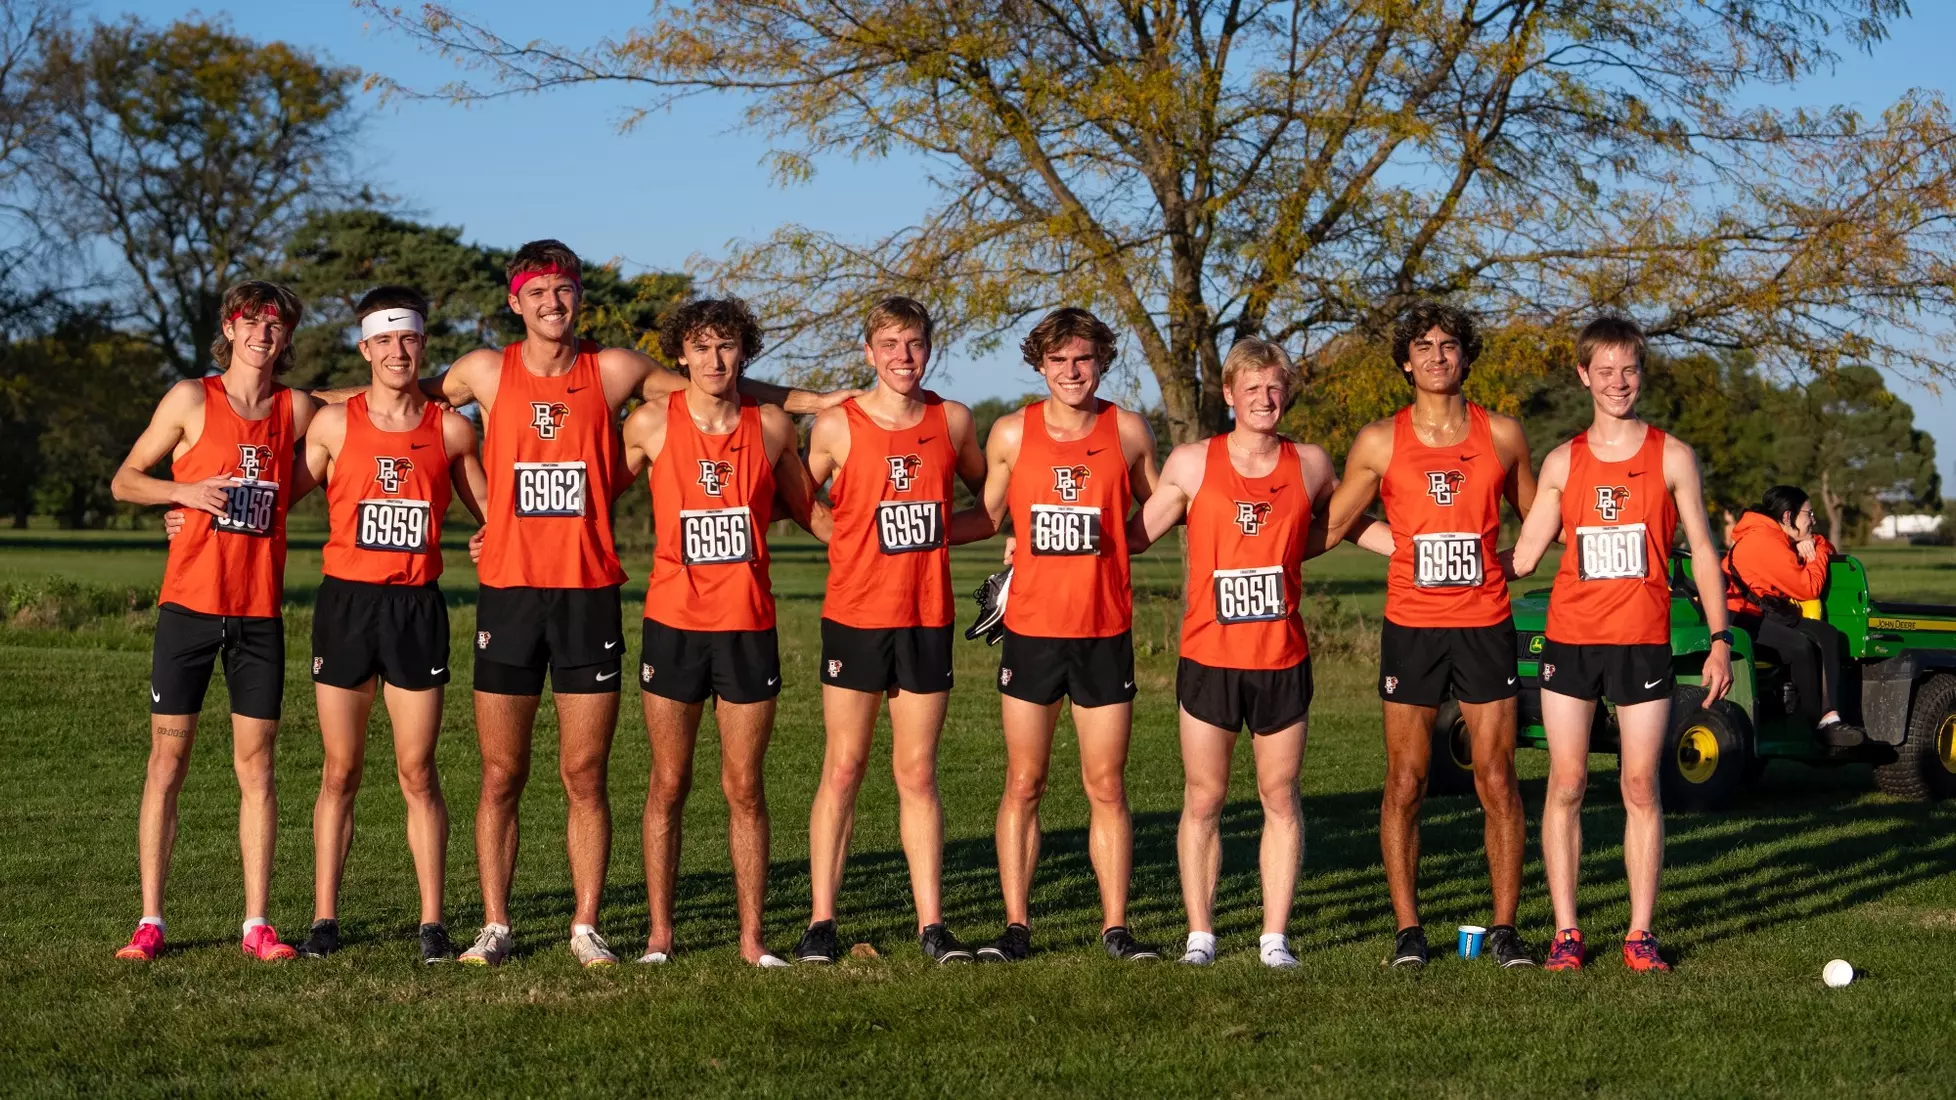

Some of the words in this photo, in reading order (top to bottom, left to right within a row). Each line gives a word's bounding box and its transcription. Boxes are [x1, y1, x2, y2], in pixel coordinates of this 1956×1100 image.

[530, 402, 557, 440] BG
[237, 444, 261, 480] BG
[374, 456, 400, 494] BG
[696, 459, 722, 497] BG
[885, 454, 912, 492] BG
[519, 469, 580, 511] 6962
[1051, 466, 1080, 502] BG
[1425, 469, 1454, 506] BG
[1233, 500, 1260, 536] BG
[1594, 486, 1619, 522] BG
[361, 504, 423, 548] 6959
[685, 515, 747, 559] 6956
[880, 503, 937, 547] 6957
[1036, 511, 1093, 552] 6961
[1419, 540, 1477, 582] 6955
[1582, 531, 1642, 574] 6960
[1219, 574, 1280, 618] 6954
[1877, 620, 1894, 629] JOHN
[1895, 620, 1917, 630] DEERE
